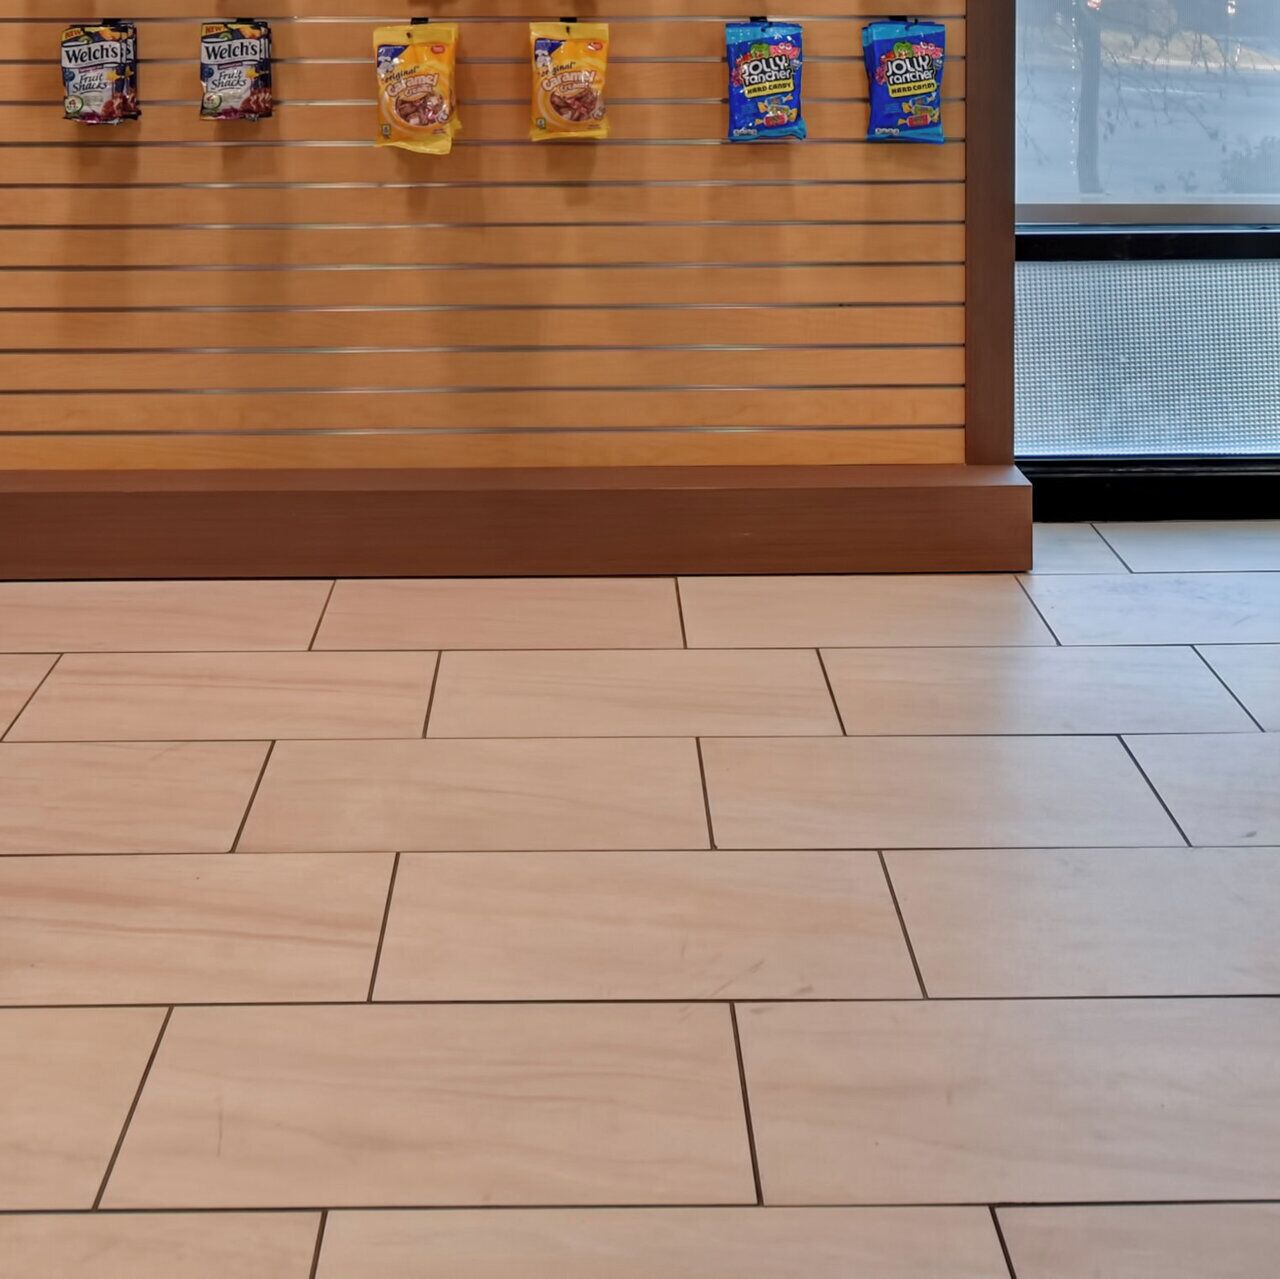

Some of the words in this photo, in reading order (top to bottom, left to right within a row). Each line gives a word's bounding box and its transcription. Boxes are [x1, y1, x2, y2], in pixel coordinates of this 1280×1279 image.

[65, 44, 119, 65] Welch's
[204, 43, 259, 63] Welch's
[742, 56, 789, 77] JOLLY
[887, 56, 931, 77] JOLLY
[79, 72, 104, 84] Fruit
[211, 77, 247, 90] Snacks
[744, 69, 791, 85] rancher
[889, 69, 933, 84] rancher
[72, 80, 109, 94] Snacks
[747, 84, 768, 95] HARD
[768, 82, 792, 92] CANDY
[891, 84, 912, 95] HARD
